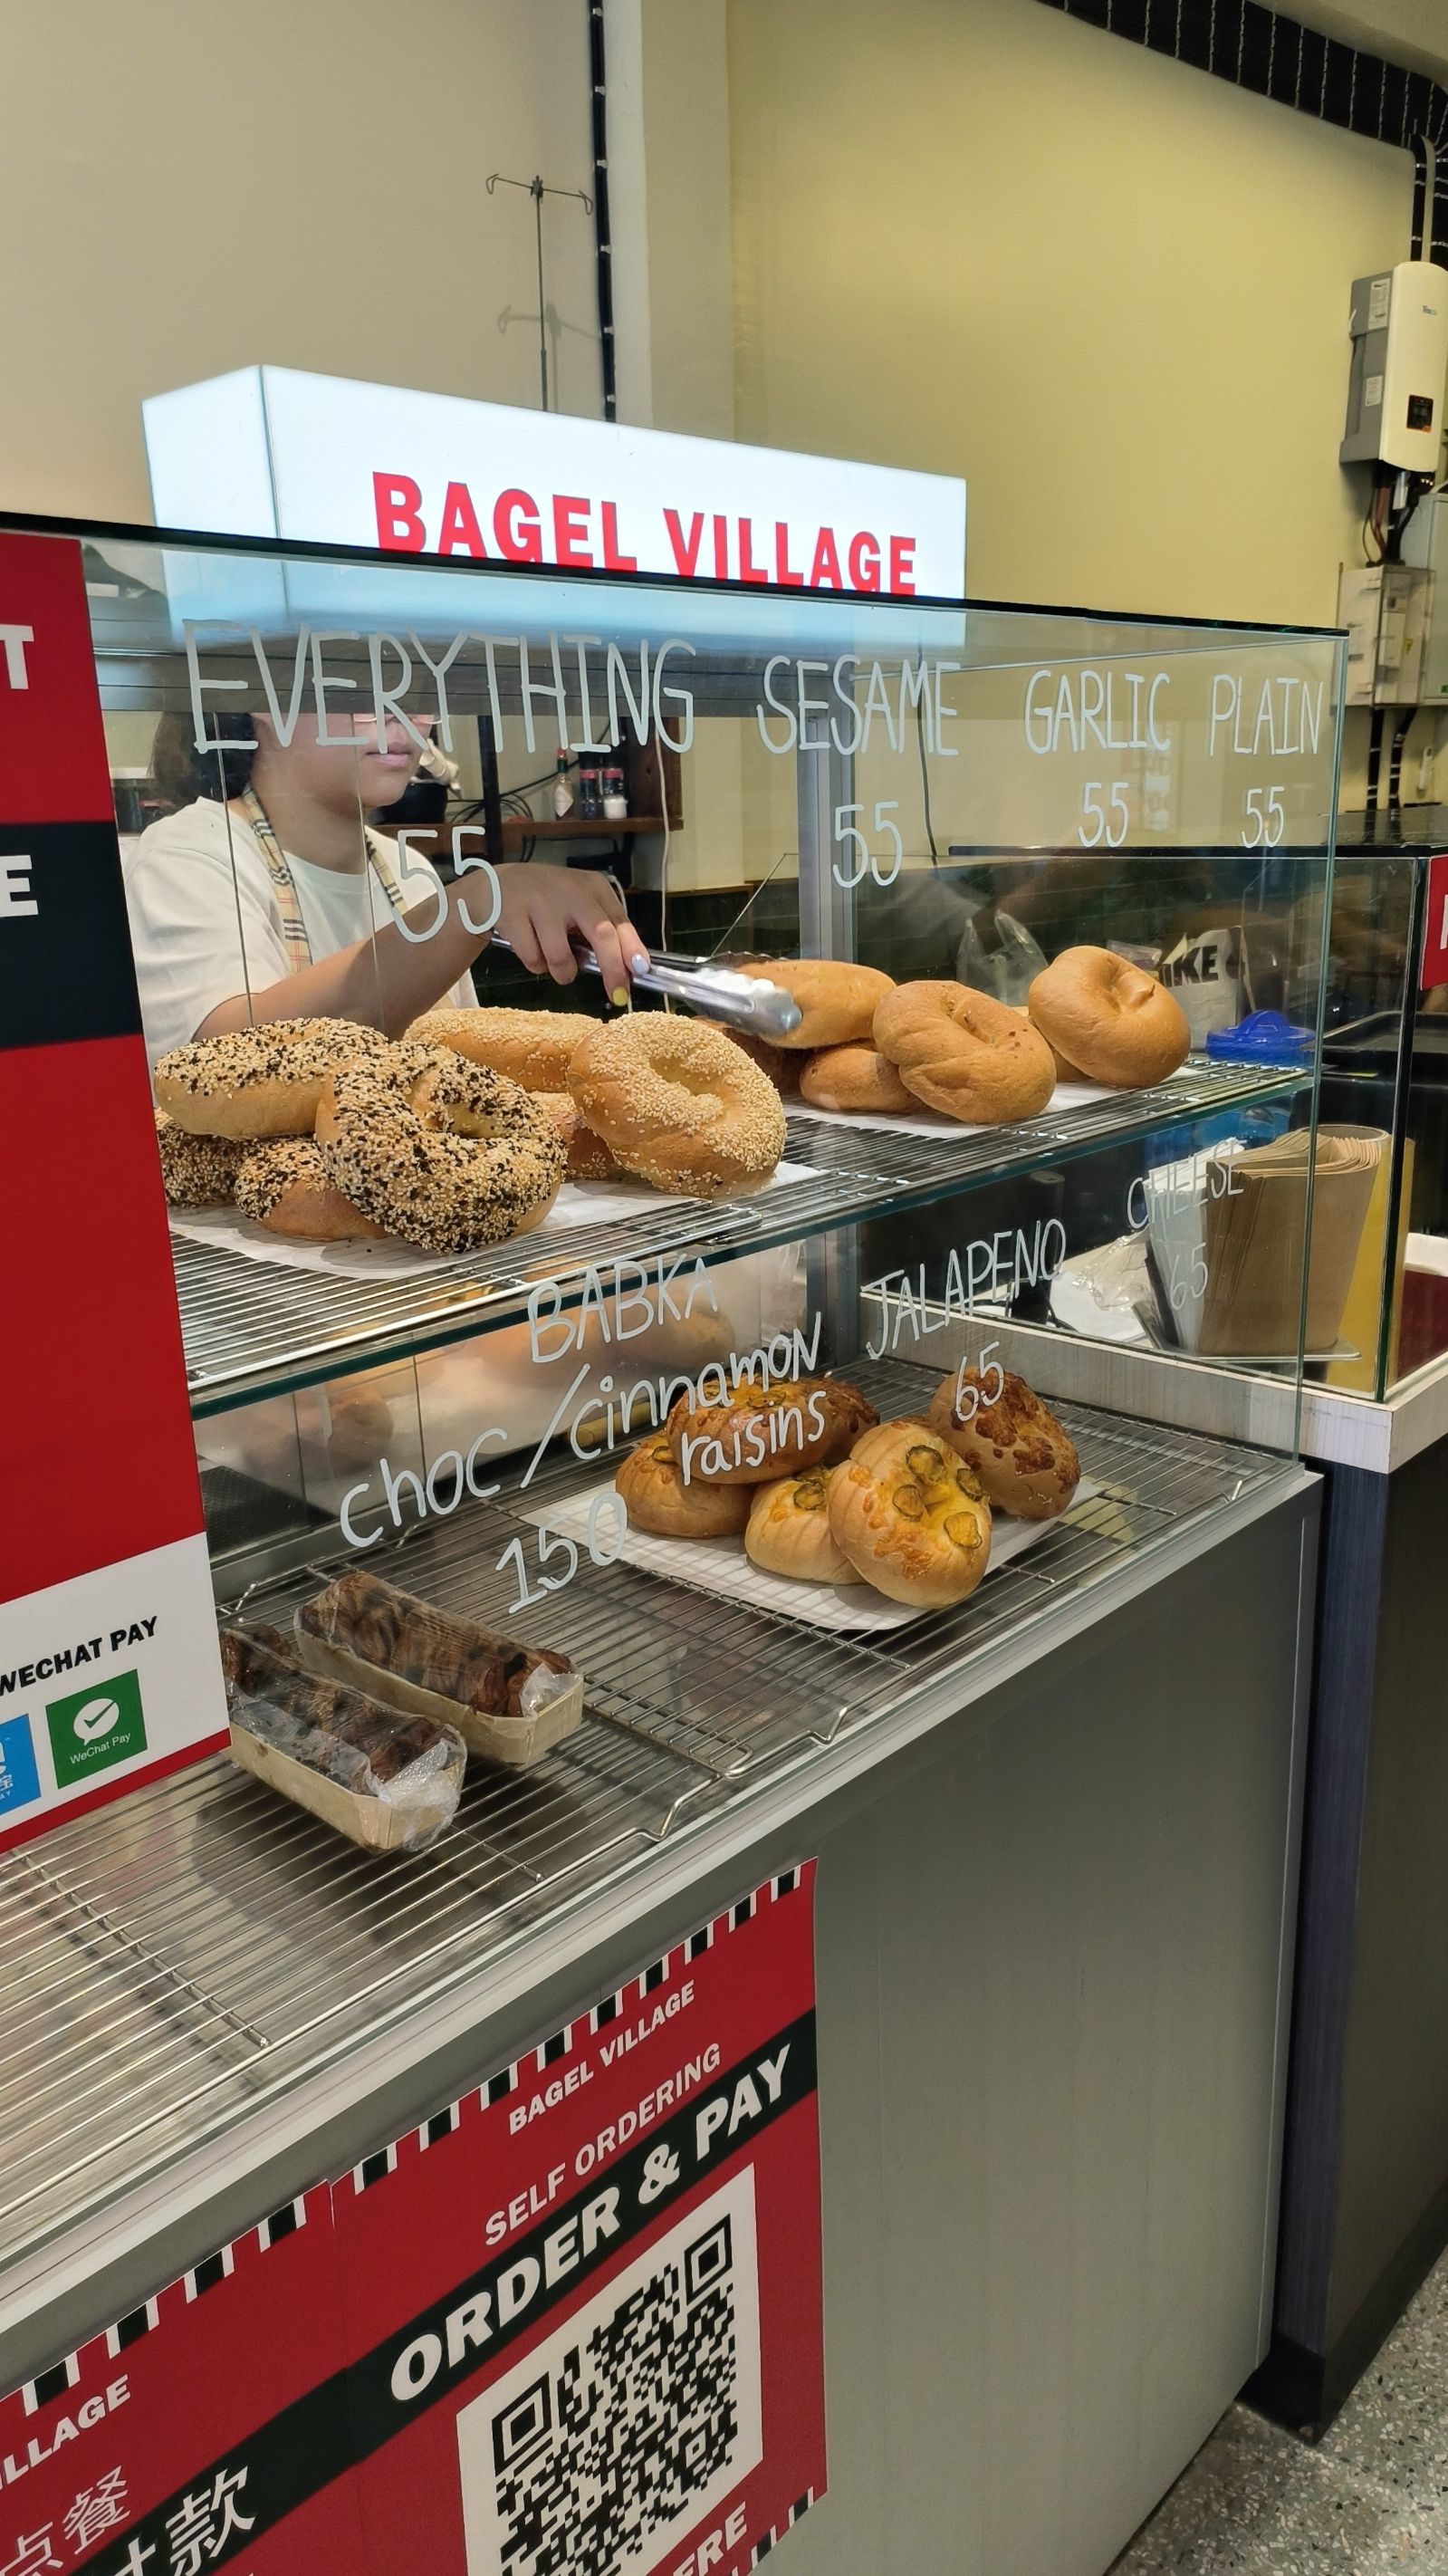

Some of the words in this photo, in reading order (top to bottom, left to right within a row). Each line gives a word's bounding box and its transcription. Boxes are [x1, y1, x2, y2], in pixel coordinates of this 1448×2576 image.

[372, 471, 638, 572] BAGEL
[663, 507, 917, 596] VILLAGE
[183, 618, 696, 754] EVERYTHING
[756, 654, 961, 756] SESAME
[1024, 668, 1171, 755] GARLIC
[1210, 673, 1323, 756] PLAIN
[832, 801, 903, 889] 55
[1078, 782, 1129, 848] 55
[1242, 785, 1285, 849] 55
[390, 825, 503, 944] 55
[1127, 1137, 1248, 1229] CHEESE
[527, 1254, 718, 1363] BABKA
[860, 1218, 1067, 1360] JALAPENO
[1169, 1242, 1209, 1311] 65
[955, 1341, 1004, 1422] 65
[681, 1390, 826, 1486] raisins
[495, 1491, 628, 1614] 150
[0, 1637, 102, 1697] WECHAT
[110, 1615, 158, 1652] PAY
[70, 1741, 110, 1764] WeChat
[112, 1733, 131, 1748] Pay
[509, 2060, 594, 2136] BAGEL
[599, 1979, 695, 2067] VILLAGE
[484, 2163, 566, 2246] SELF
[575, 2043, 722, 2176] ORDERING
[390, 2186, 621, 2401] ORDER
[638, 2143, 680, 2205] &
[695, 2043, 791, 2161] PAY
